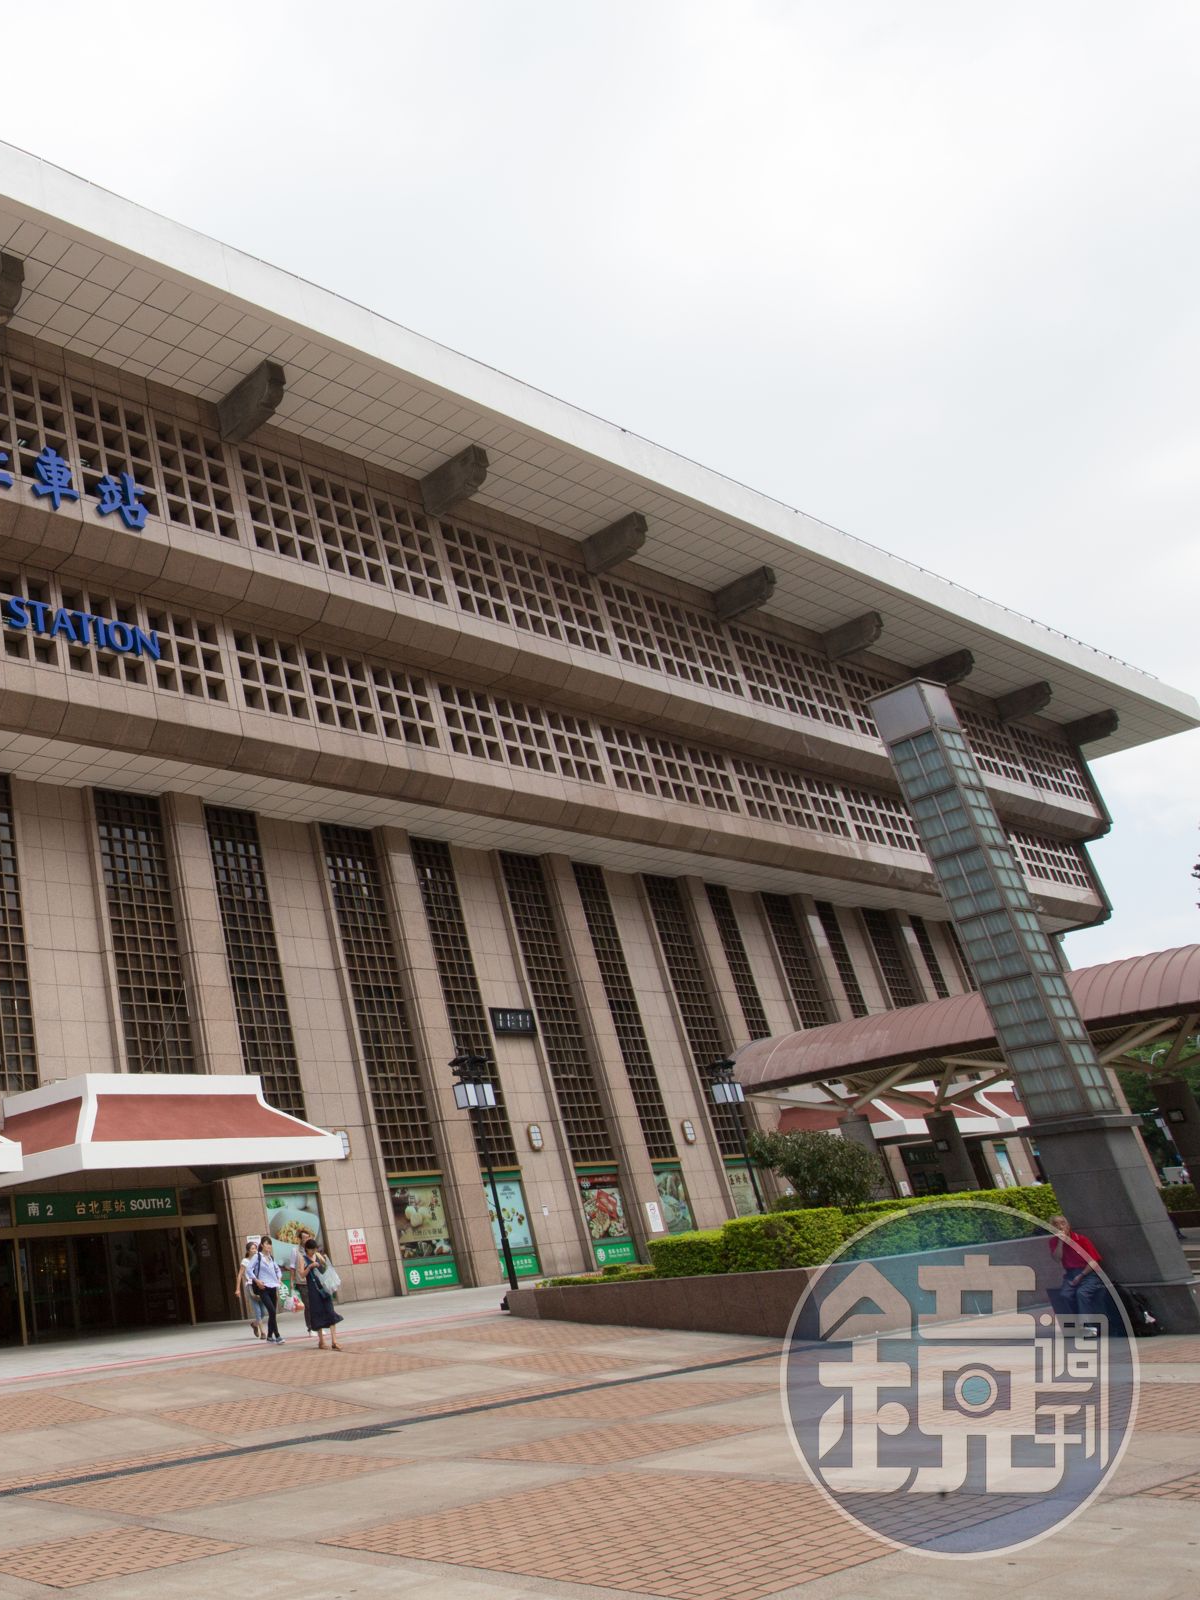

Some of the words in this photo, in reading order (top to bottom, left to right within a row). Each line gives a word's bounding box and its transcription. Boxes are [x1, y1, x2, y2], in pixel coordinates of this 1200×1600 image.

[7, 596, 161, 661] STATION
[27, 1202, 40, 1217] 南
[46, 1204, 54, 1216] 2
[75, 1200, 126, 1215] 台北車站
